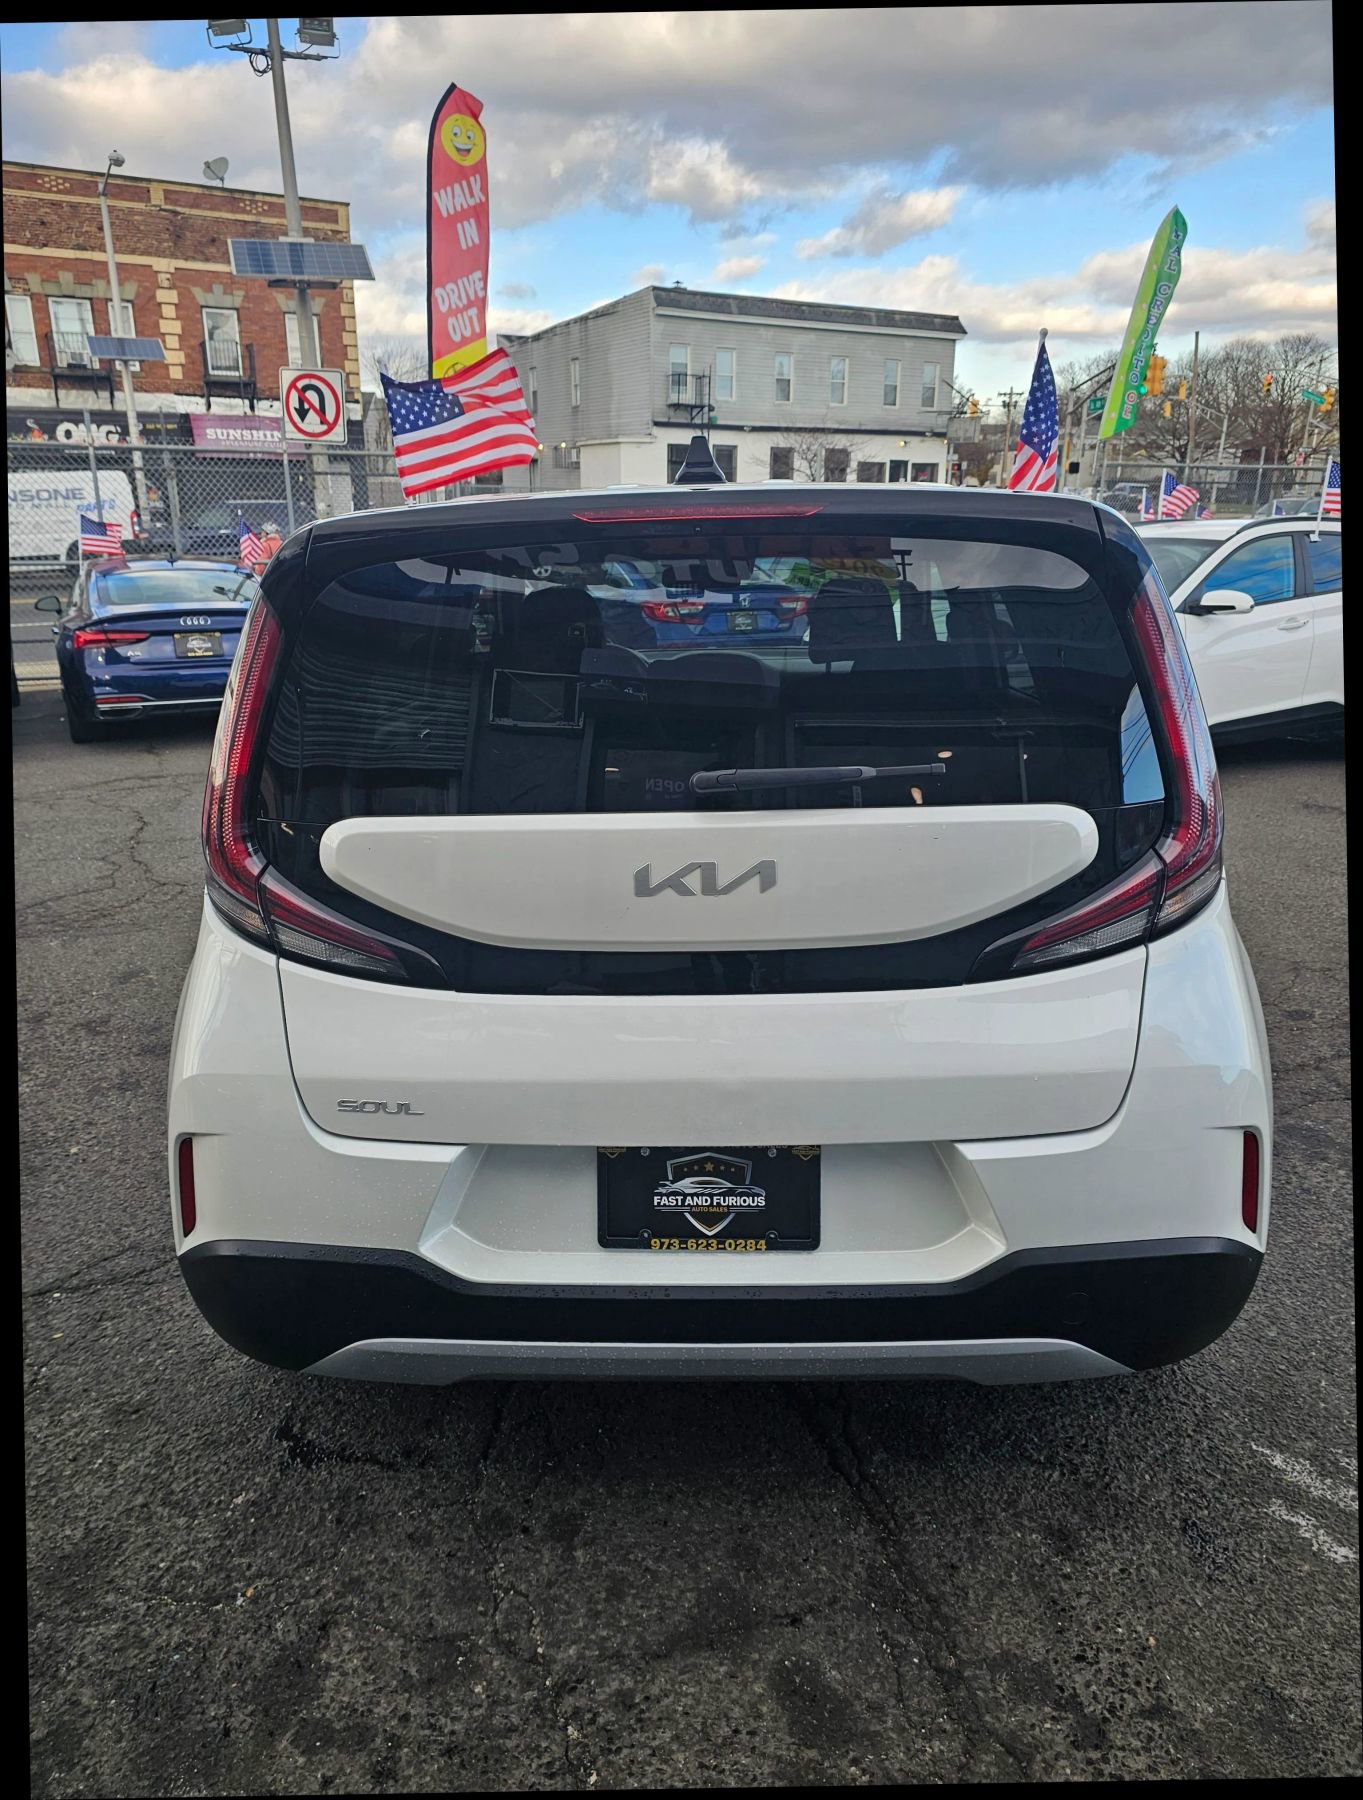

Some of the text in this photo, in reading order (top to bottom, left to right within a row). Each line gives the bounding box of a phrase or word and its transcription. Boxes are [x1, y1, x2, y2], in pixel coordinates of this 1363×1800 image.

[434, 174, 486, 218] WALK
[456, 218, 480, 250] IN
[435, 270, 485, 314] DRIVE
[447, 306, 480, 343] OUT
[206, 428, 283, 442] SUNSHIN
[634, 859, 776, 897] KIA
[337, 1098, 425, 1115] SOUL
[653, 1195, 766, 1207] FAST AND FURIOUS
[650, 1238, 767, 1251] 973-623-0284
